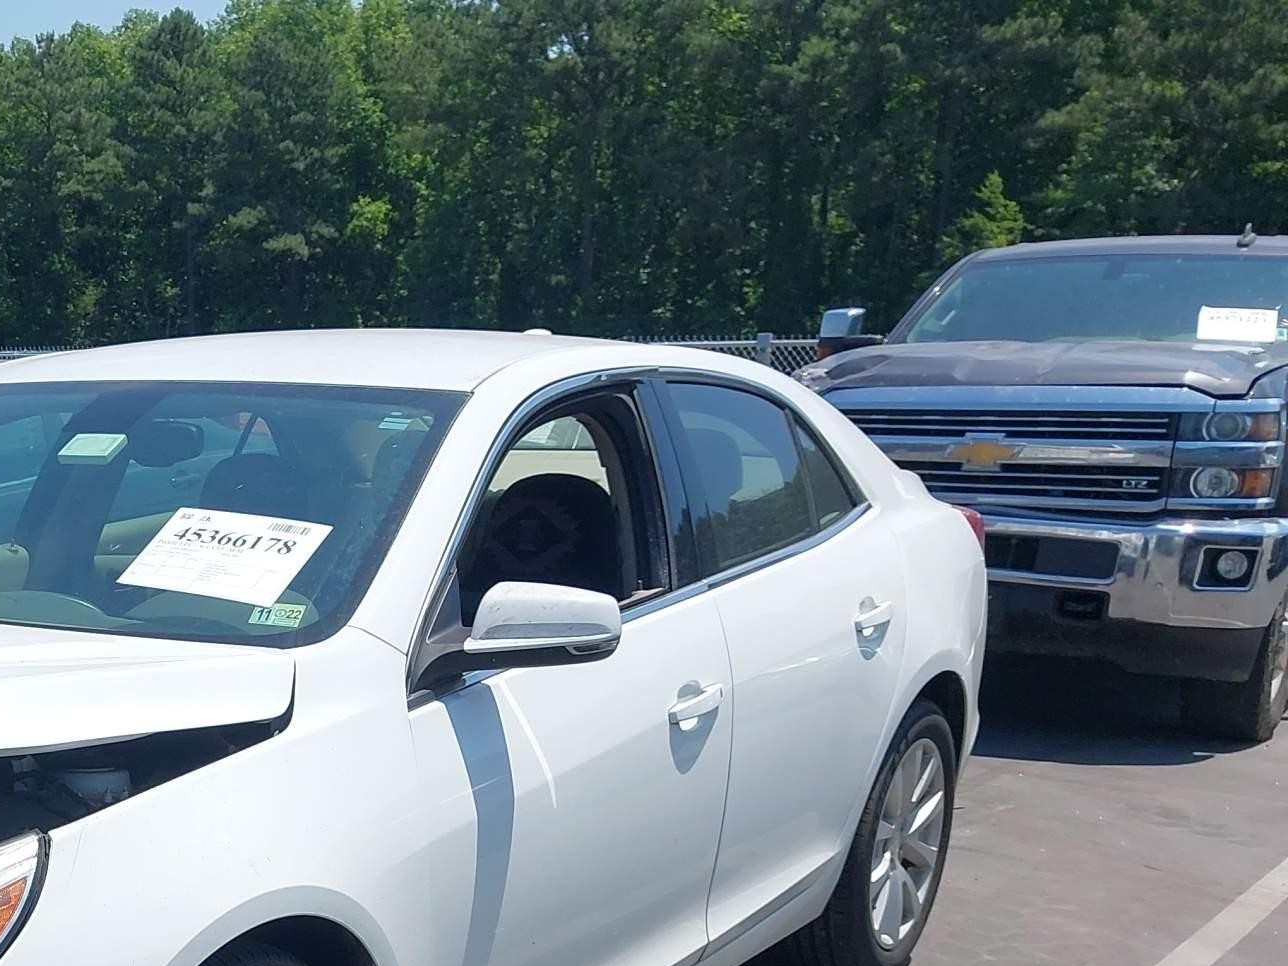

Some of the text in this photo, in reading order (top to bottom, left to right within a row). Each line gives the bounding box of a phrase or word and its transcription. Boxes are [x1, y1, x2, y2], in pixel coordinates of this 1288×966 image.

[1122, 480, 1149, 489] LTZ
[173, 526, 297, 555] 45366178
[257, 608, 302, 621] 11 22
